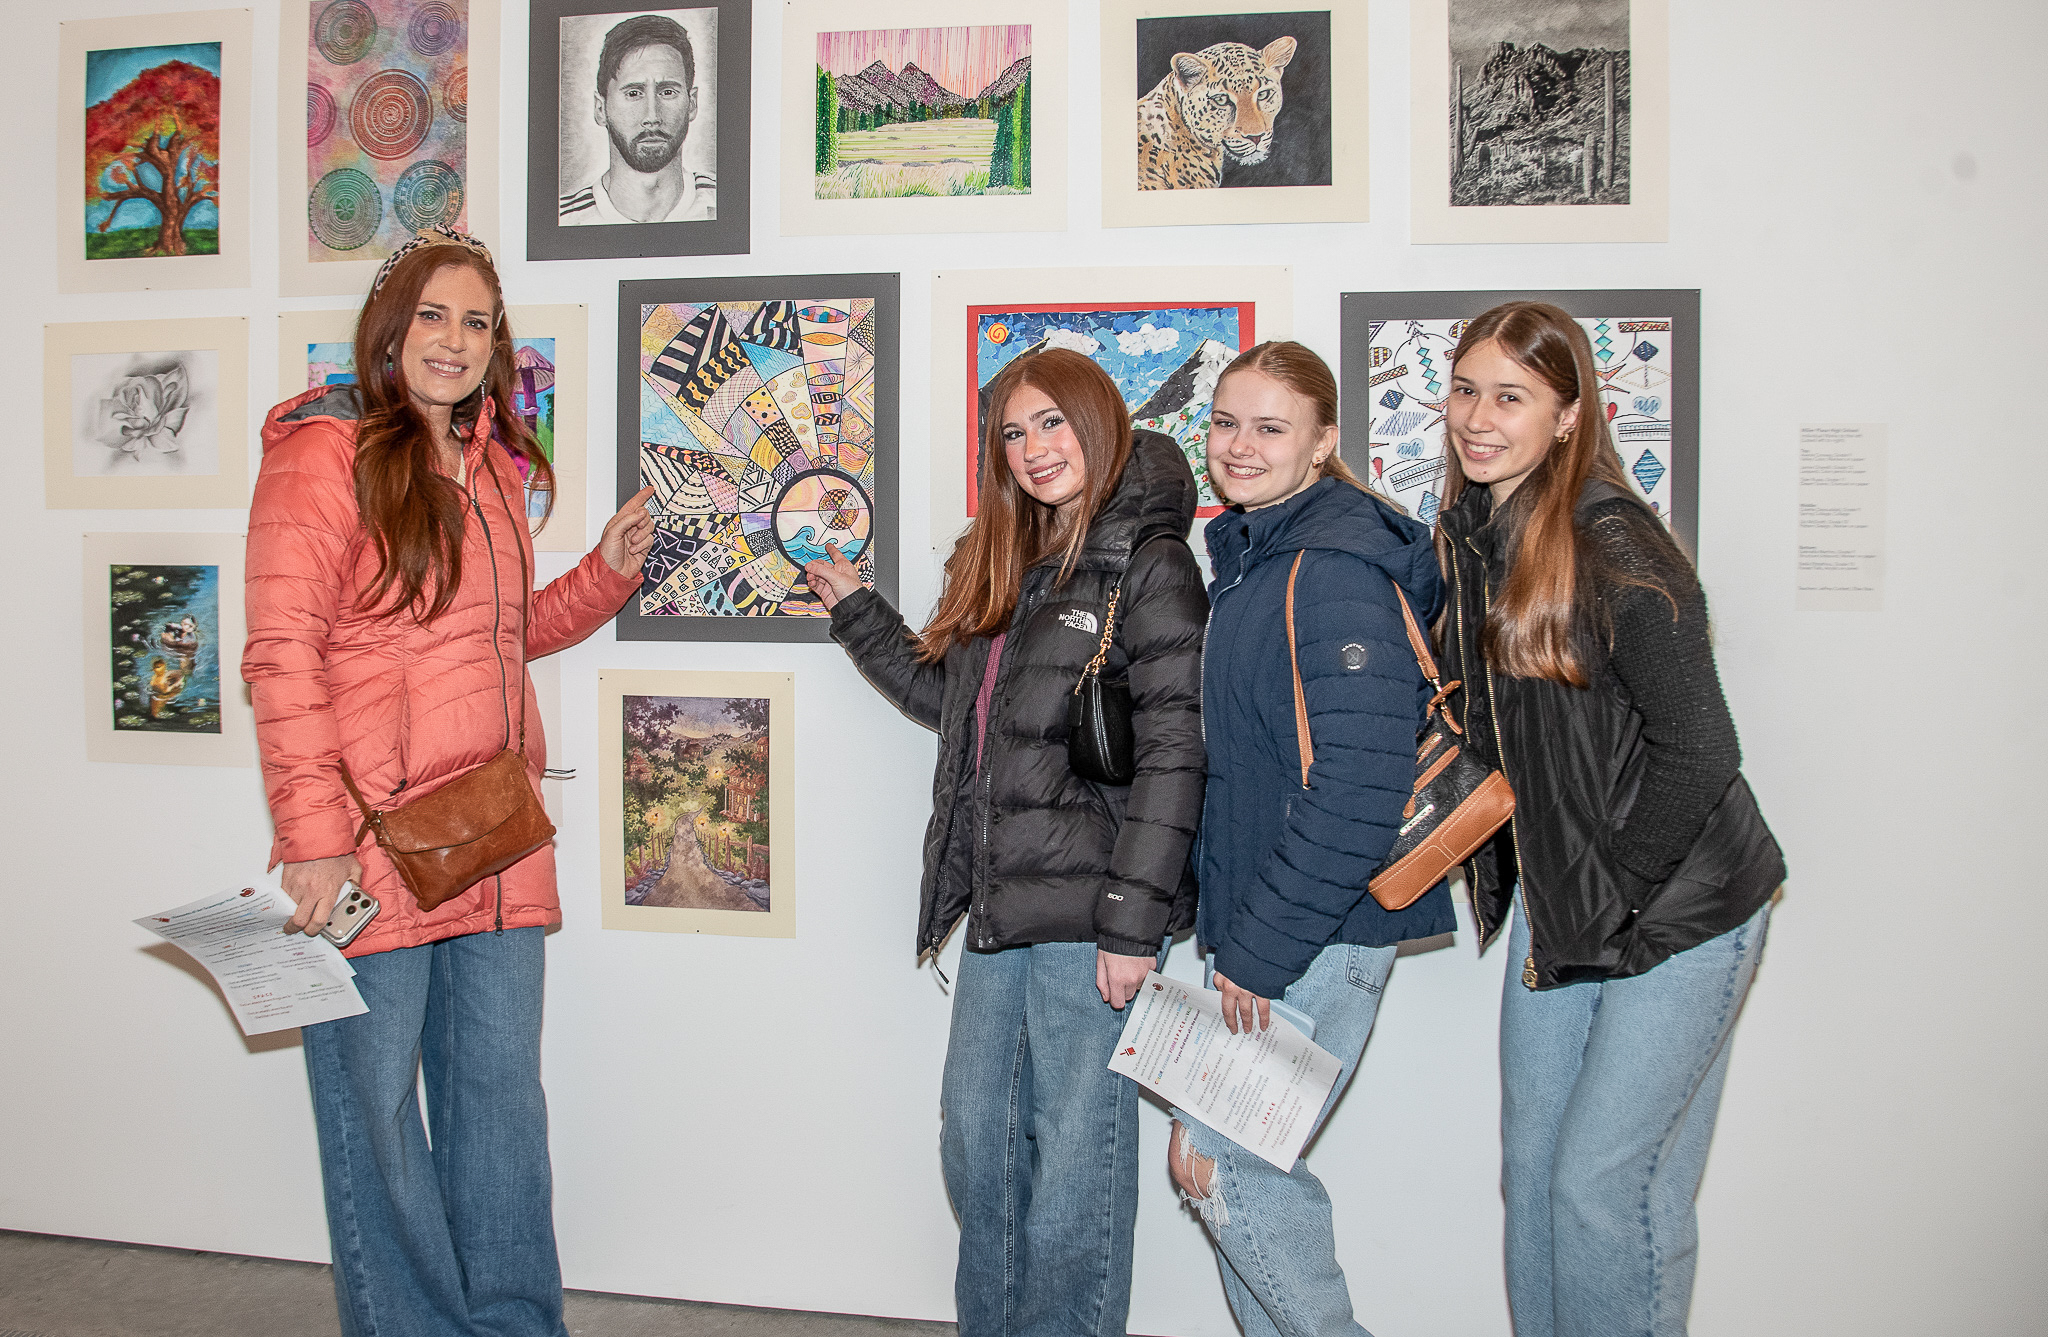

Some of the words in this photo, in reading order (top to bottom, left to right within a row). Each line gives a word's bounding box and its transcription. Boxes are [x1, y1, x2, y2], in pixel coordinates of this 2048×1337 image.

[1072, 608, 1088, 618] THE
[1058, 614, 1086, 624] NORTH
[1064, 620, 1084, 630] FACE
[1342, 643, 1365, 652] NAUTICA
